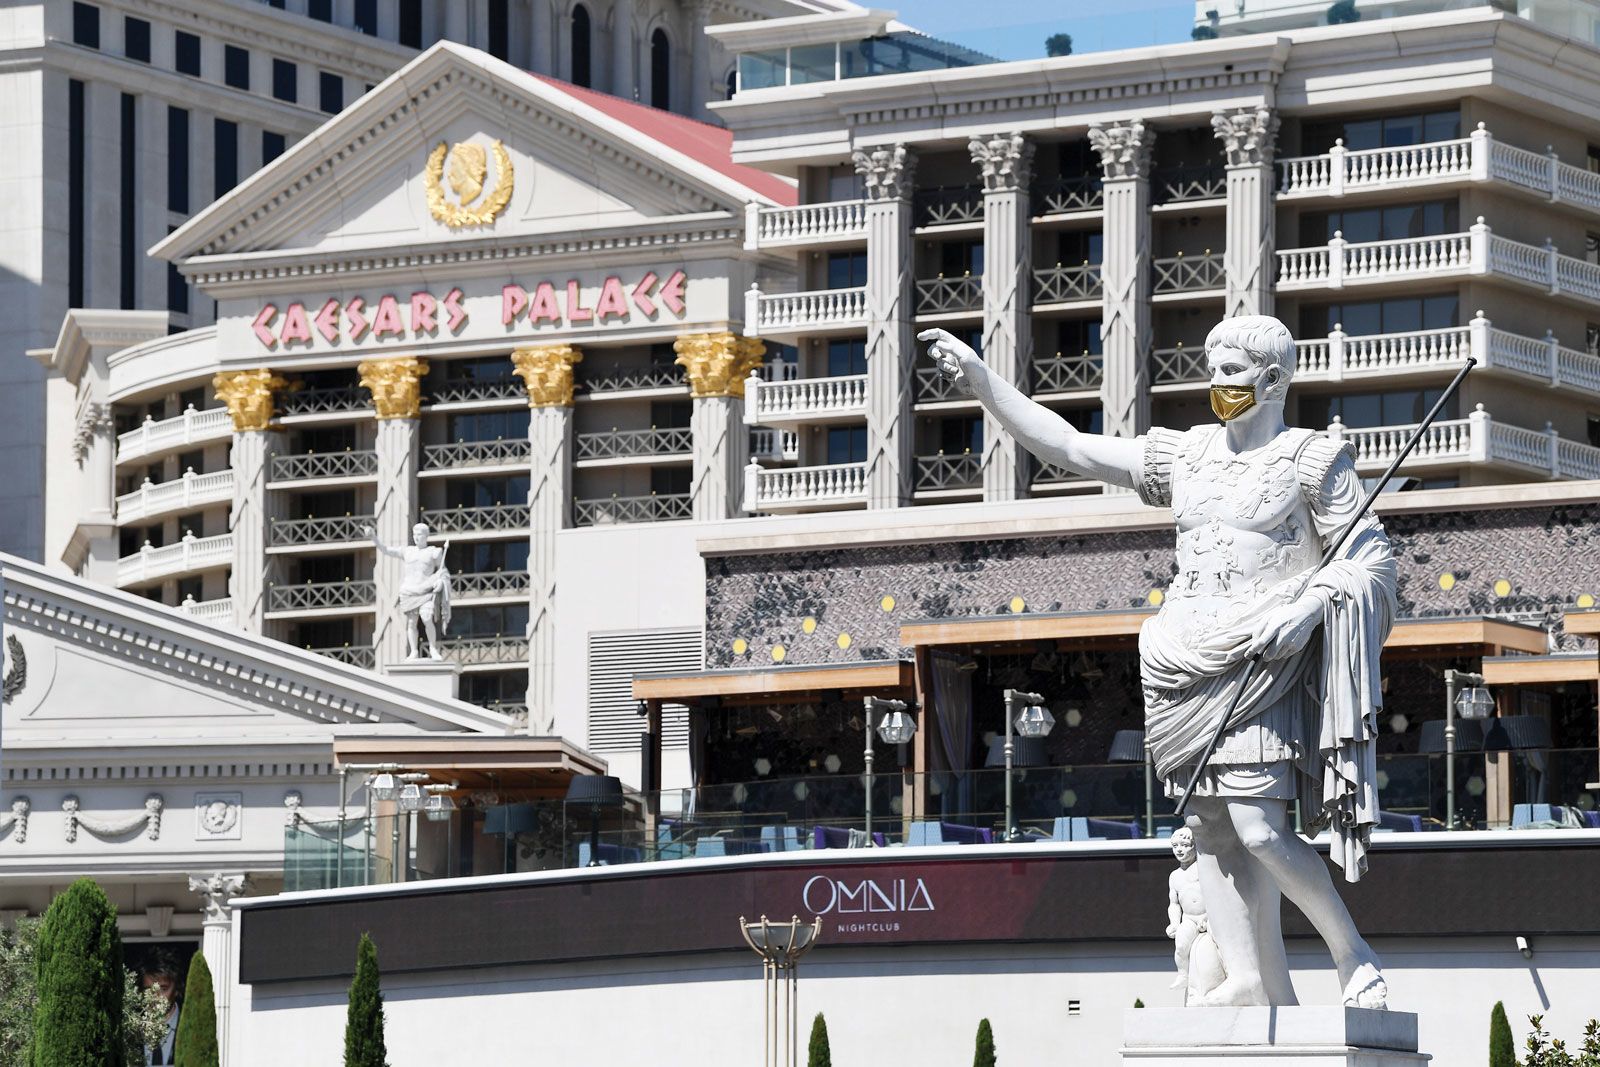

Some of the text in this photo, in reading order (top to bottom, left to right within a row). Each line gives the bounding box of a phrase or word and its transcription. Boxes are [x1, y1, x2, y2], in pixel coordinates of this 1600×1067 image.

[251, 270, 687, 347] CAESARS PALACE
[803, 875, 935, 914] OMNIA
[838, 922, 900, 932] NIGHTCLUB
